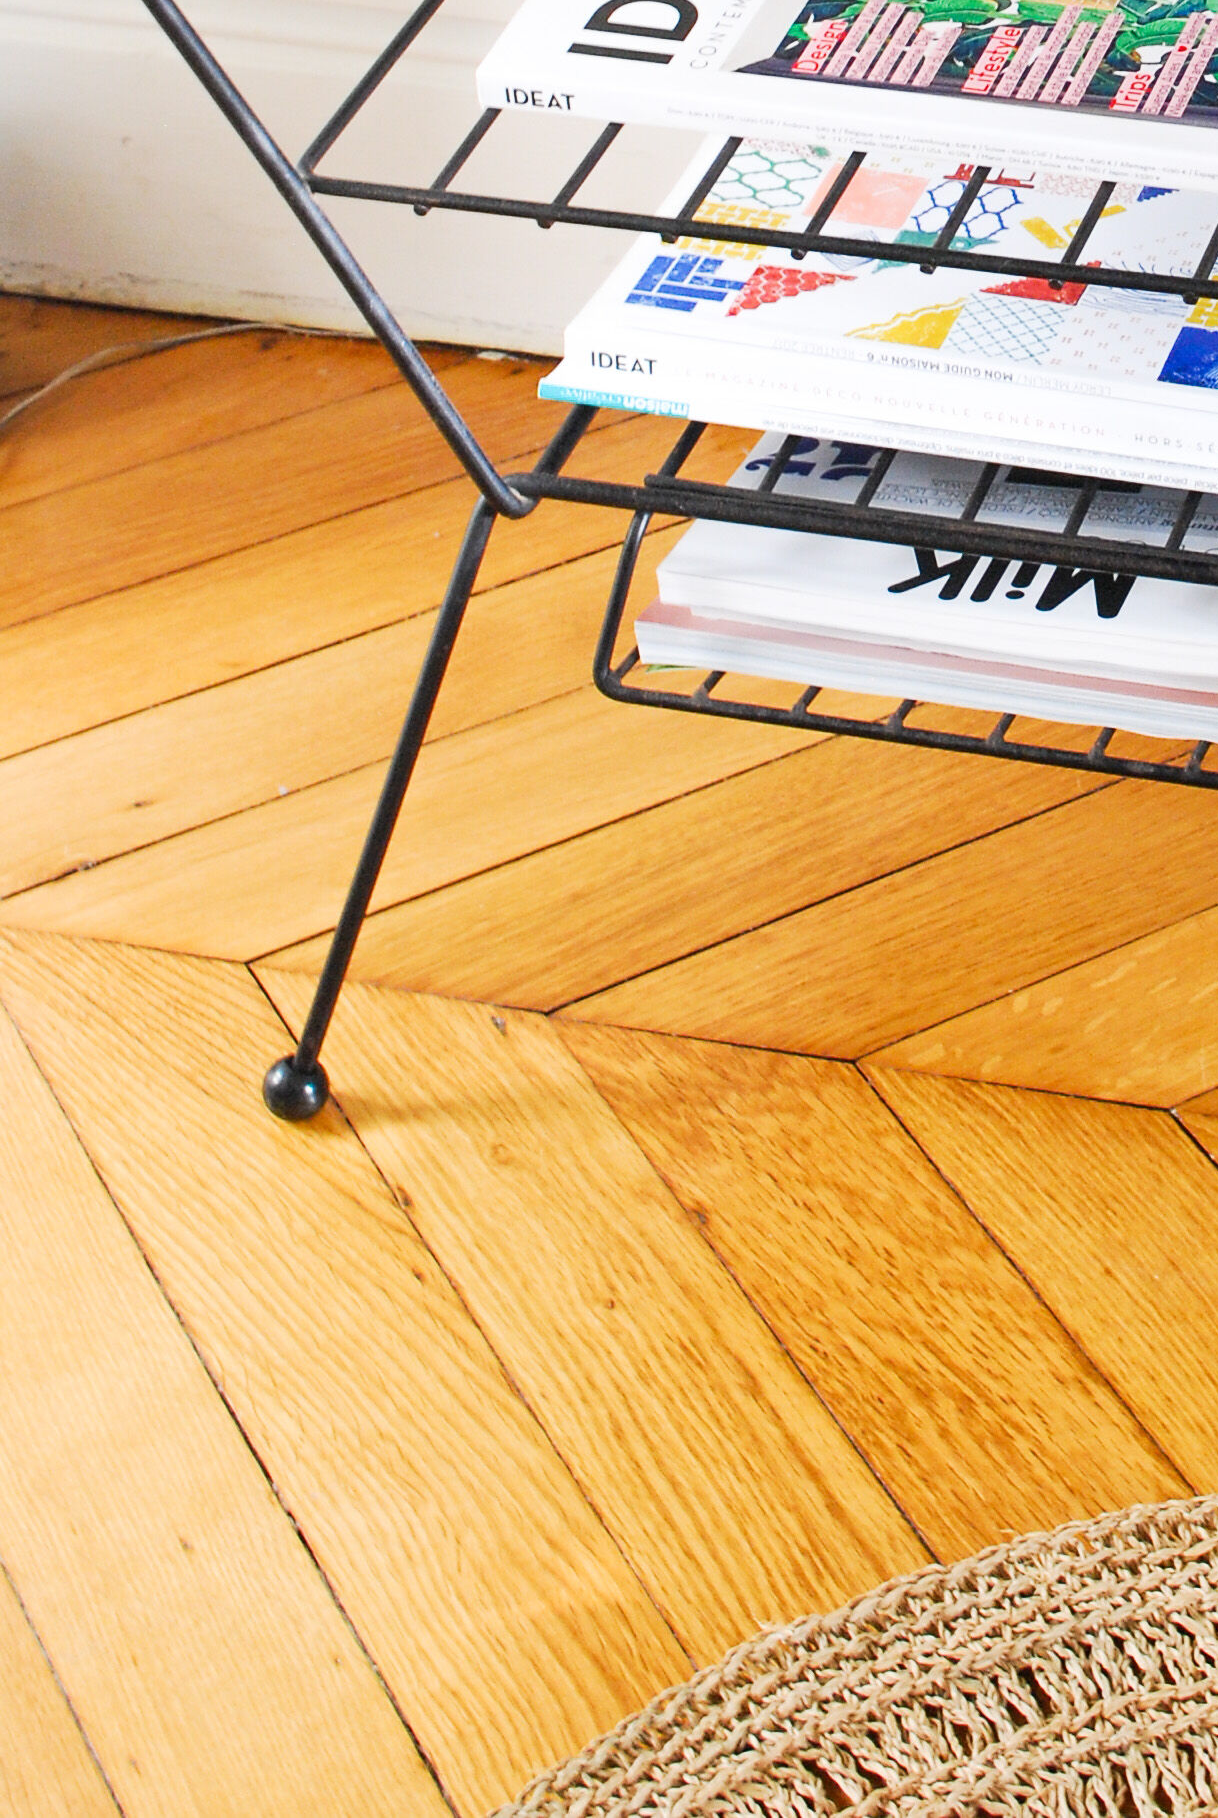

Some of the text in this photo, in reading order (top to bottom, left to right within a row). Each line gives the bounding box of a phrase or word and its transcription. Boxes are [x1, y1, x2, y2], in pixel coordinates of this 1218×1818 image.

[793, 21, 849, 71] Design
[962, 27, 1021, 93] Lifestyle
[504, 86, 575, 112] IDEAT
[1110, 73, 1152, 110] Trips
[770, 338, 804, 354] 2017
[590, 351, 659, 375] IDEAT
[892, 354, 941, 373] MAISON
[943, 363, 981, 378] GUIDE
[984, 368, 1014, 382] MON
[1022, 374, 1071, 391] MERLIN
[1073, 380, 1112, 395] LEROY
[622, 395, 689, 417] maison
[705, 371, 800, 391] MAGAZINE
[874, 395, 971, 417] NOUVELLE
[983, 405, 1106, 438] GÉNÉRATION
[790, 422, 818, 436] pièces
[1004, 453, 1025, 466] déco
[1027, 456, 1062, 471] conseils
[1075, 463, 1098, 476] idées
[1099, 467, 1116, 479] 100
[1146, 473, 1162, 484] par
[1163, 476, 1188, 490] pièce
